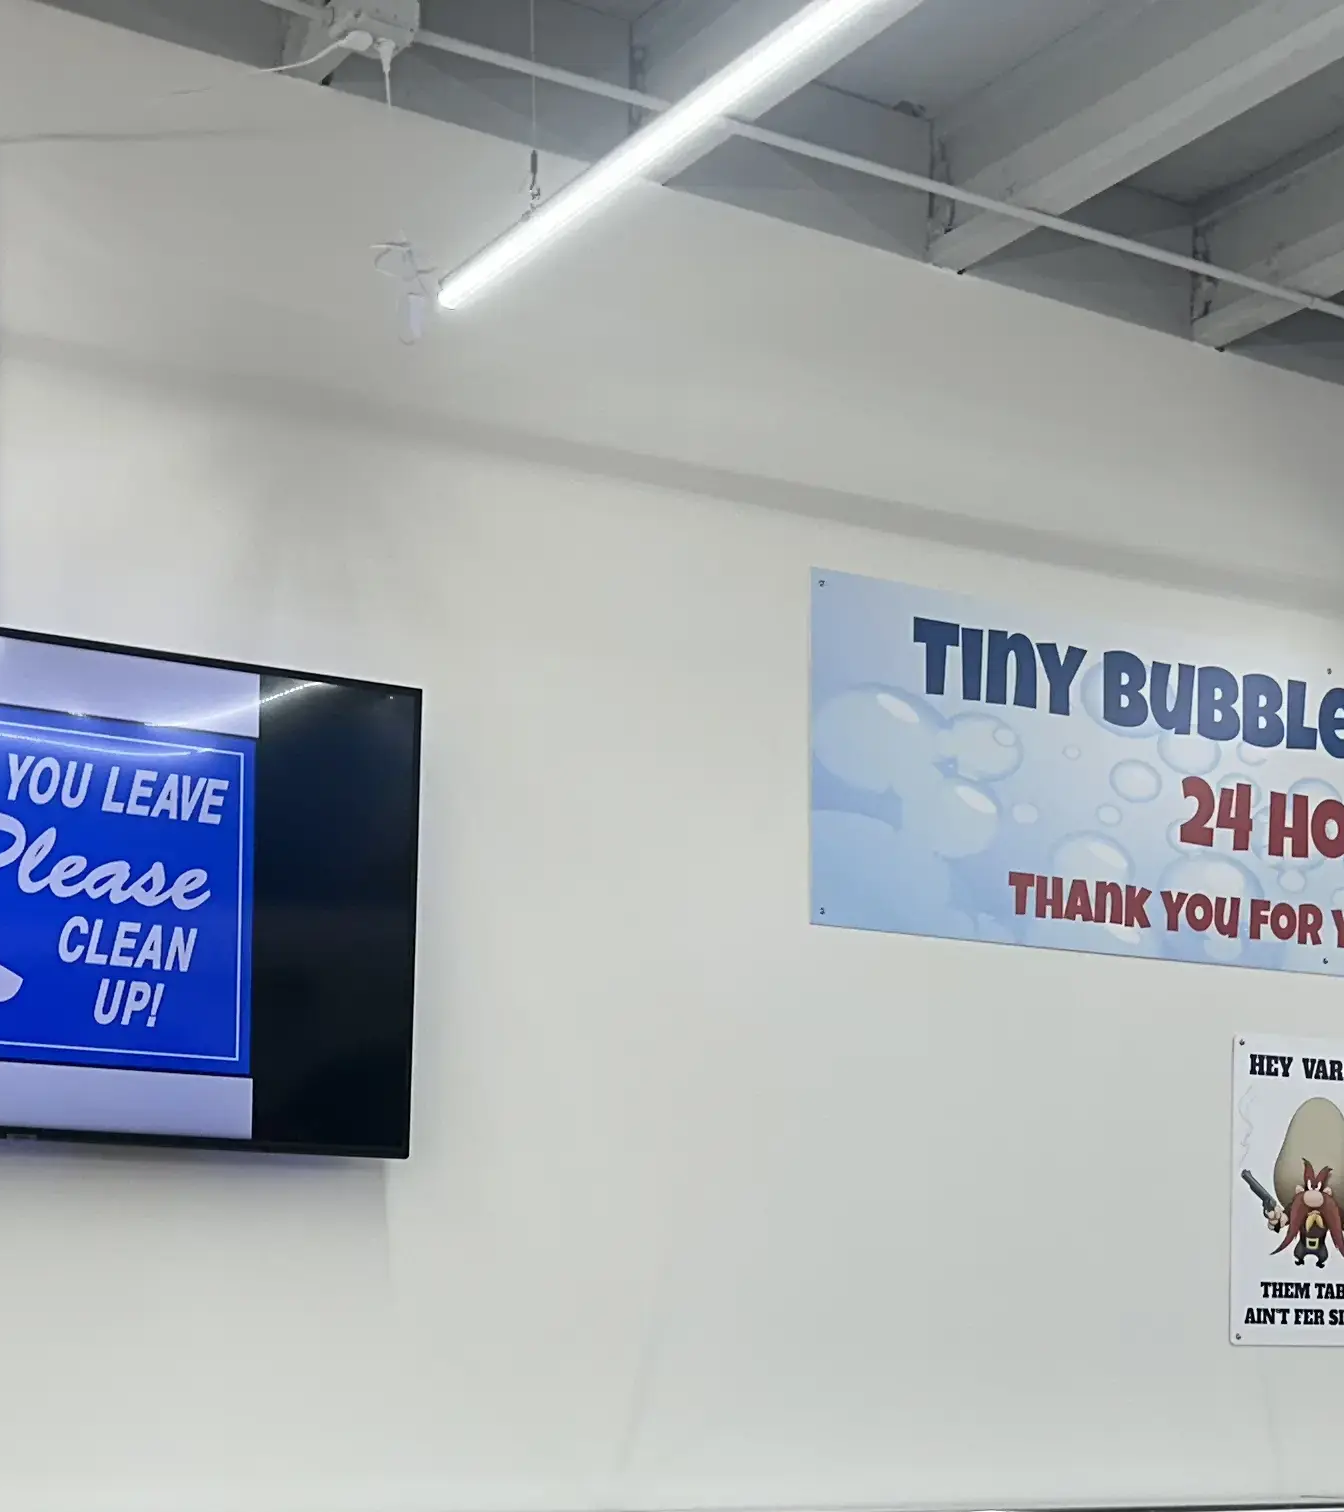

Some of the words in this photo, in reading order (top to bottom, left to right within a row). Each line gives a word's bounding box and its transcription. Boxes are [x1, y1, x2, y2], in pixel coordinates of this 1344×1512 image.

[911, 615, 1089, 716] TINY
[5, 752, 92, 811] YOU
[100, 765, 231, 826] LEAVE
[1178, 775, 1255, 857] 24
[1007, 870, 1152, 930] THANK
[1160, 889, 1242, 940] YOU
[1247, 898, 1324, 947] FOR
[56, 914, 198, 973] CLEAN
[92, 977, 164, 1028] UP!
[1249, 1053, 1294, 1078] HEY
[1244, 1307, 1290, 1325] AIN'T
[1293, 1308, 1325, 1326] FER
[1260, 1281, 1311, 1299] THEM
